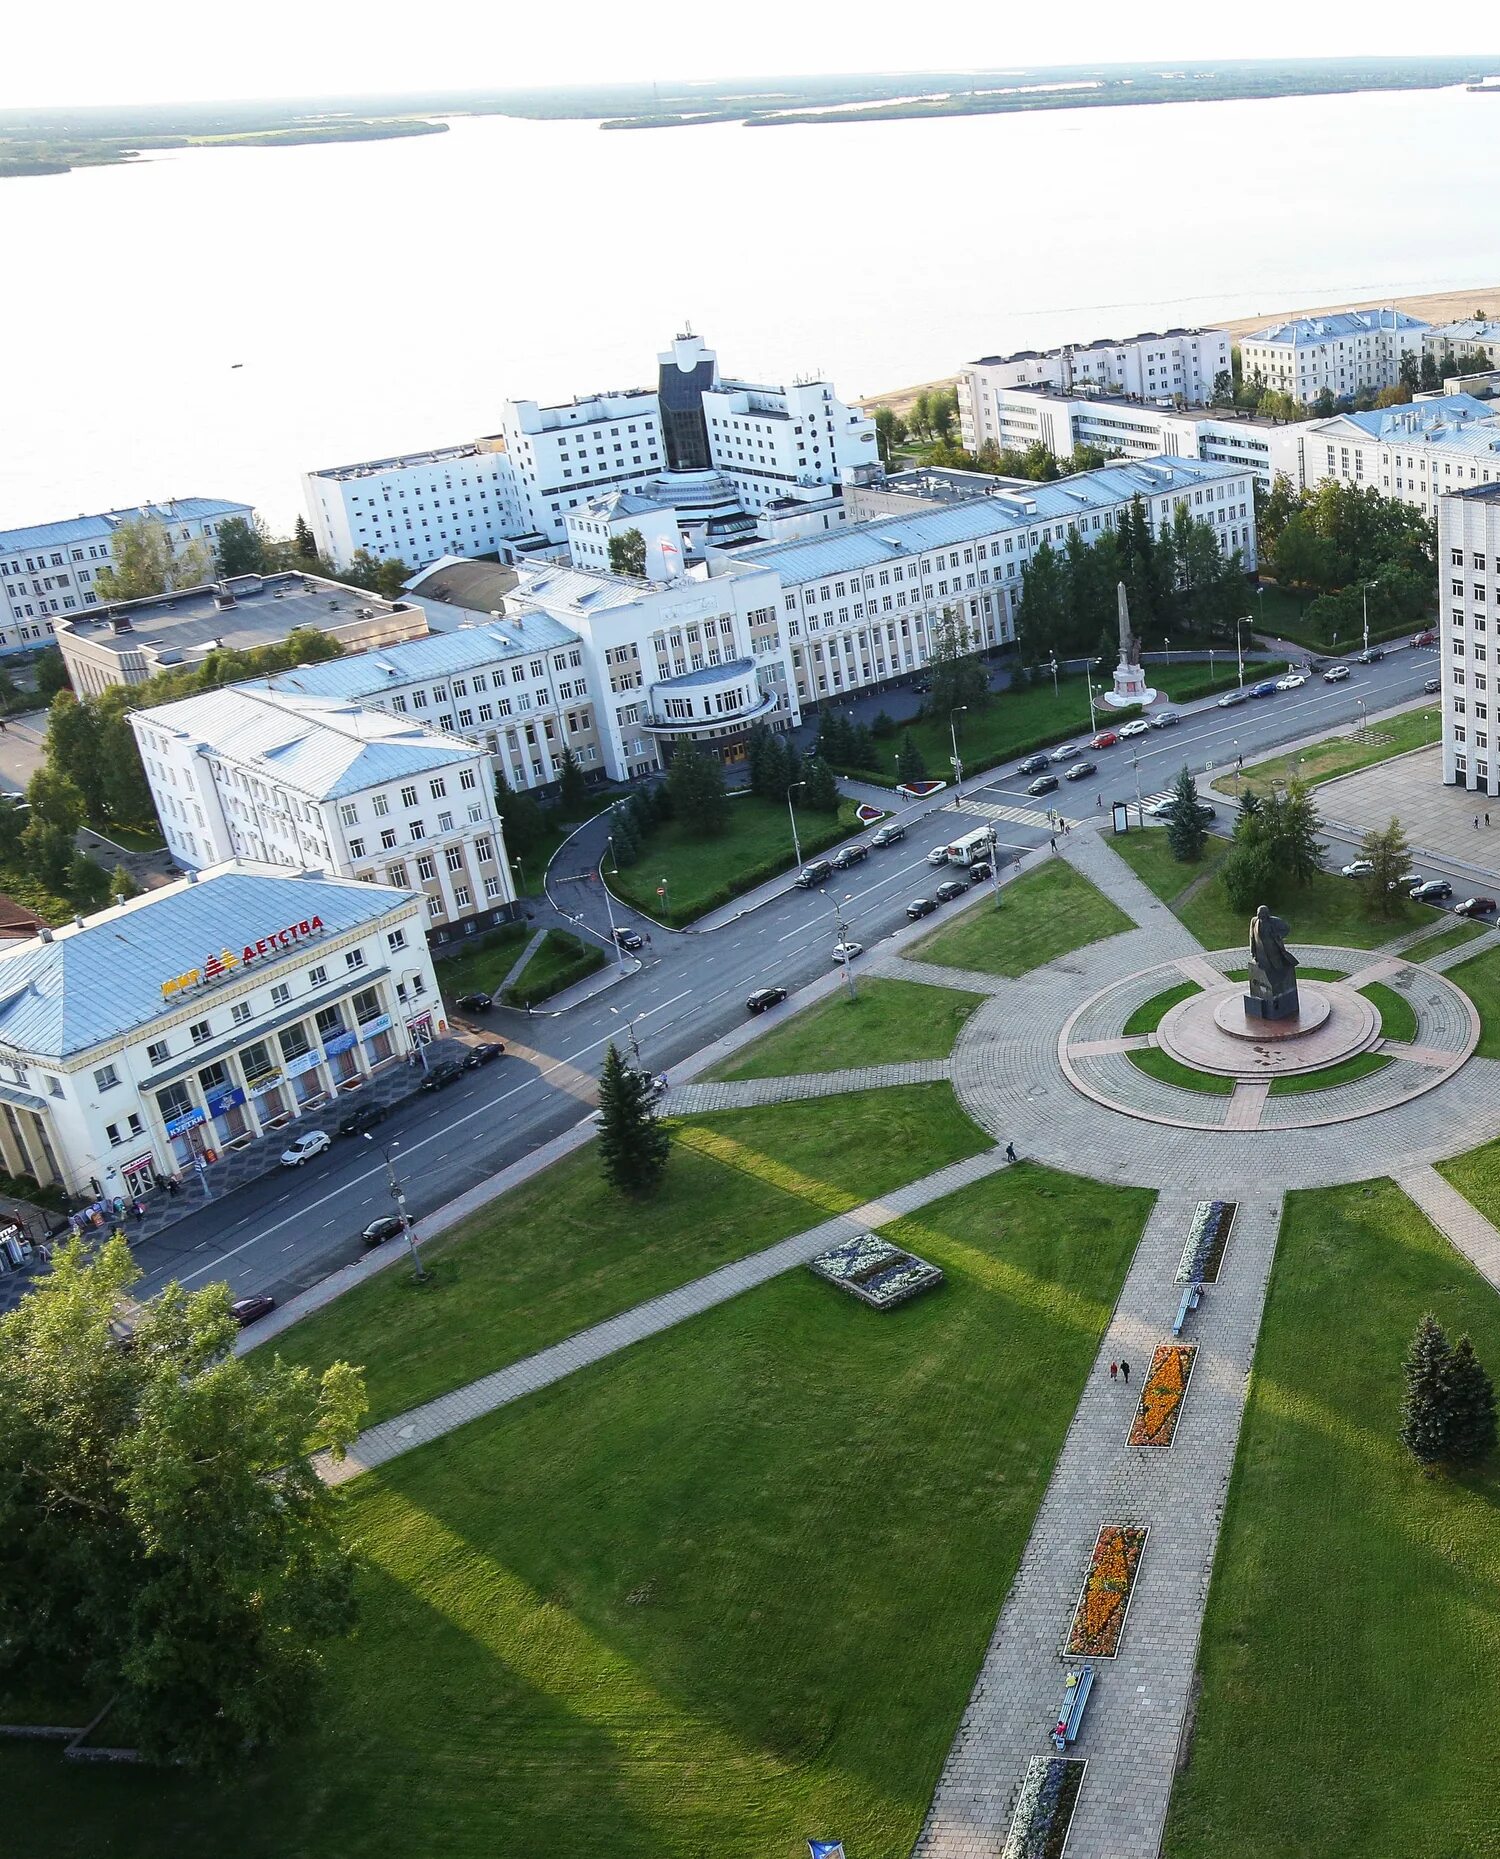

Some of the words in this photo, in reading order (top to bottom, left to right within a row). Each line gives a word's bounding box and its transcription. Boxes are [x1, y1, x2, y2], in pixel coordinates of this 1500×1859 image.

[162, 968, 200, 997] МИР
[242, 914, 324, 962] ДЕТСТВА
[170, 1115, 204, 1136] КУРТКИ
